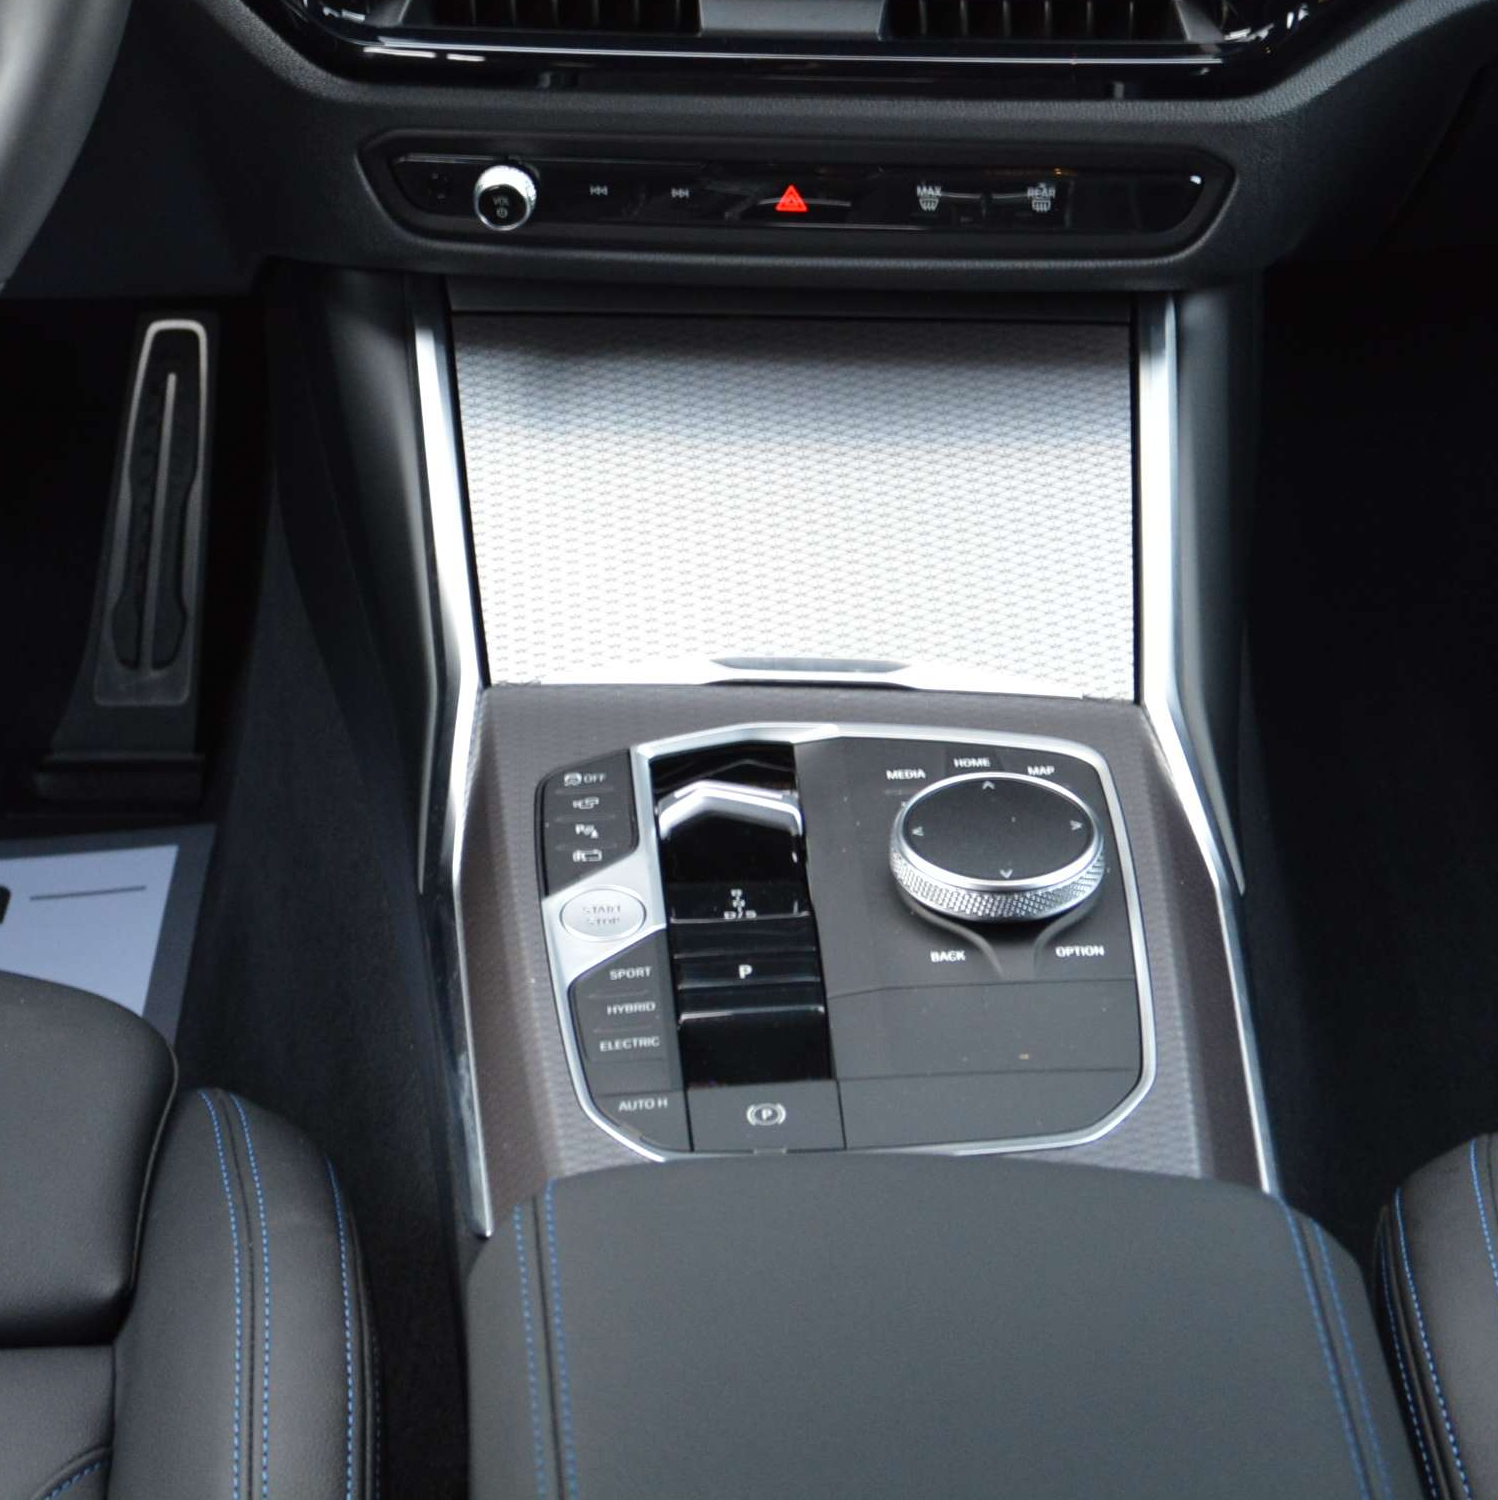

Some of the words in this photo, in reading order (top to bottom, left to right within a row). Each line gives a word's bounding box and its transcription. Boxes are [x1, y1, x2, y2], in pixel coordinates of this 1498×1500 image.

[916, 185, 942, 197] MAX
[954, 757, 990, 768] HOME
[886, 768, 926, 780] MEDIA
[1028, 765, 1055, 777] MAP
[583, 773, 606, 784] OFF
[930, 950, 966, 963] BACK
[1055, 945, 1105, 958] OPTION
[609, 966, 652, 981] SPORT
[739, 964, 753, 979] P
[606, 1001, 656, 1016] HYBRID
[599, 1035, 661, 1053] ELECTRIC
[618, 1098, 655, 1113] AUTO
[657, 1097, 668, 1110] H
